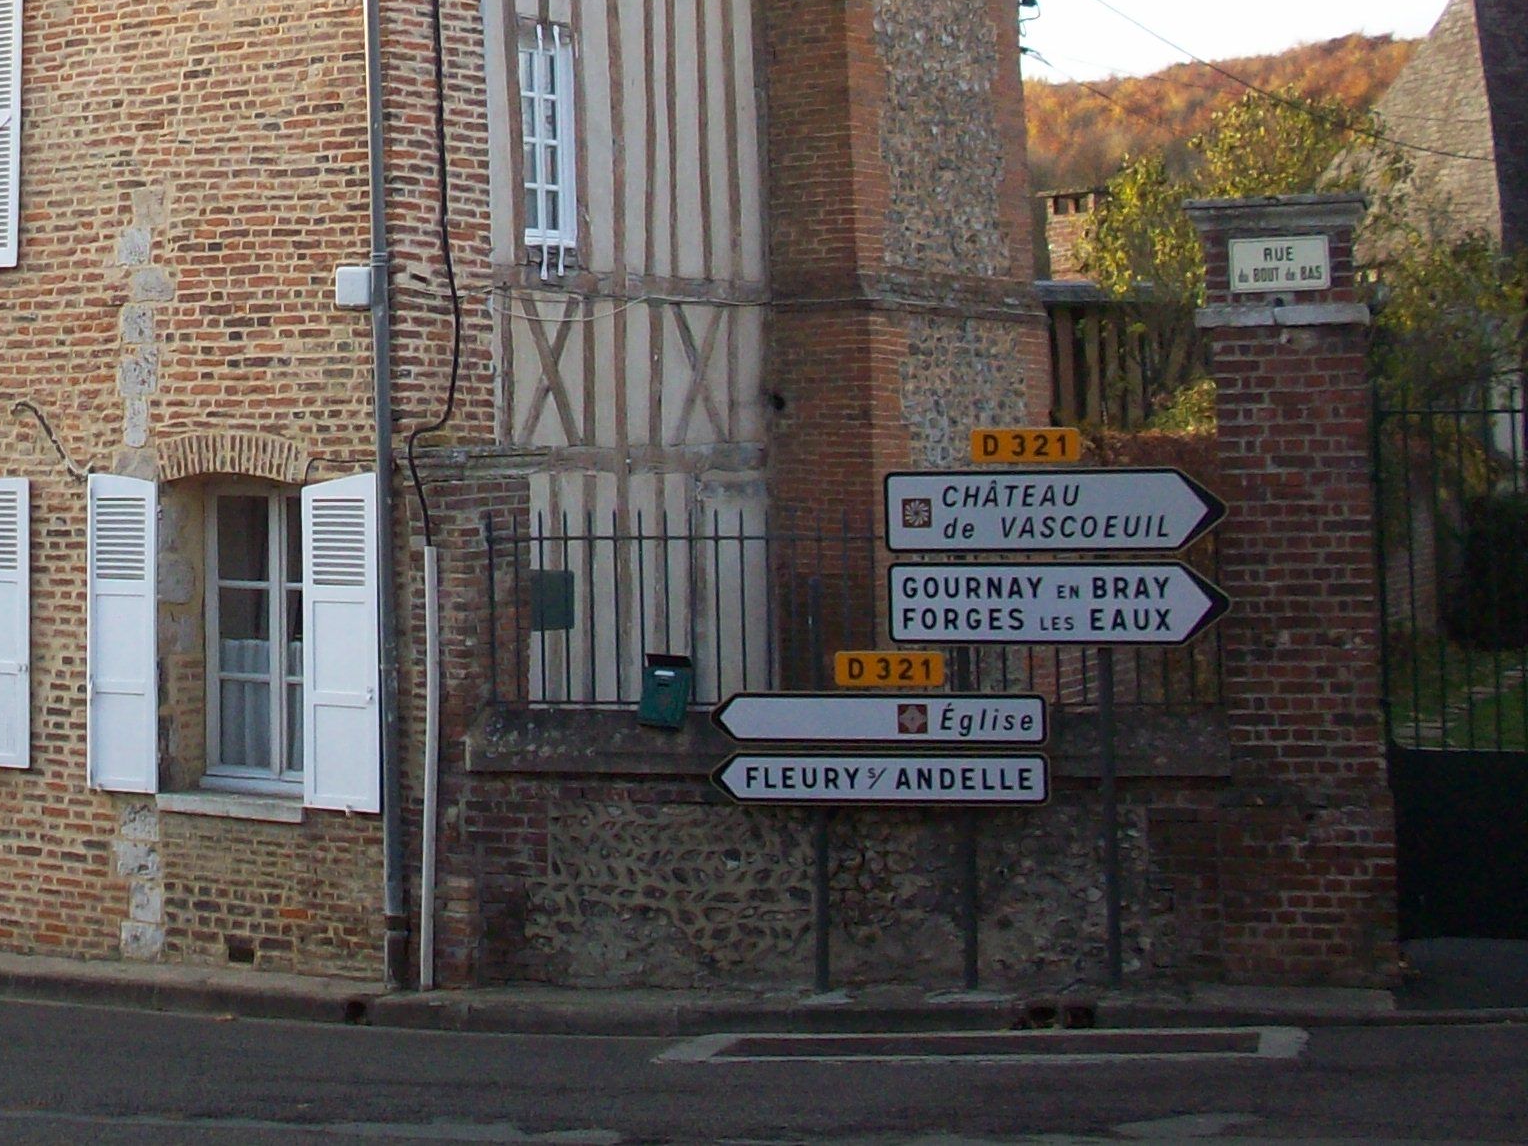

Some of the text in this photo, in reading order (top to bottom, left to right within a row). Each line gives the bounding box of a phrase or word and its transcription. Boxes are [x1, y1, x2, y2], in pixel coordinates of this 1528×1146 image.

[1263, 246, 1294, 262] RUE
[1253, 267, 1280, 282] BOUT
[1300, 265, 1322, 280] BAS
[982, 434, 1070, 457] D 321
[942, 480, 1080, 508] CHÂTEAU
[943, 515, 1170, 540] de VASCOEUIL
[902, 576, 1170, 600] GOURNAY EN BRAY
[902, 608, 1171, 631] FORGES LES EAUX
[848, 658, 933, 680] D 321
[940, 703, 1034, 736] Église
[745, 767, 860, 789] FLEURY
[895, 767, 1034, 790] ANDELLE
